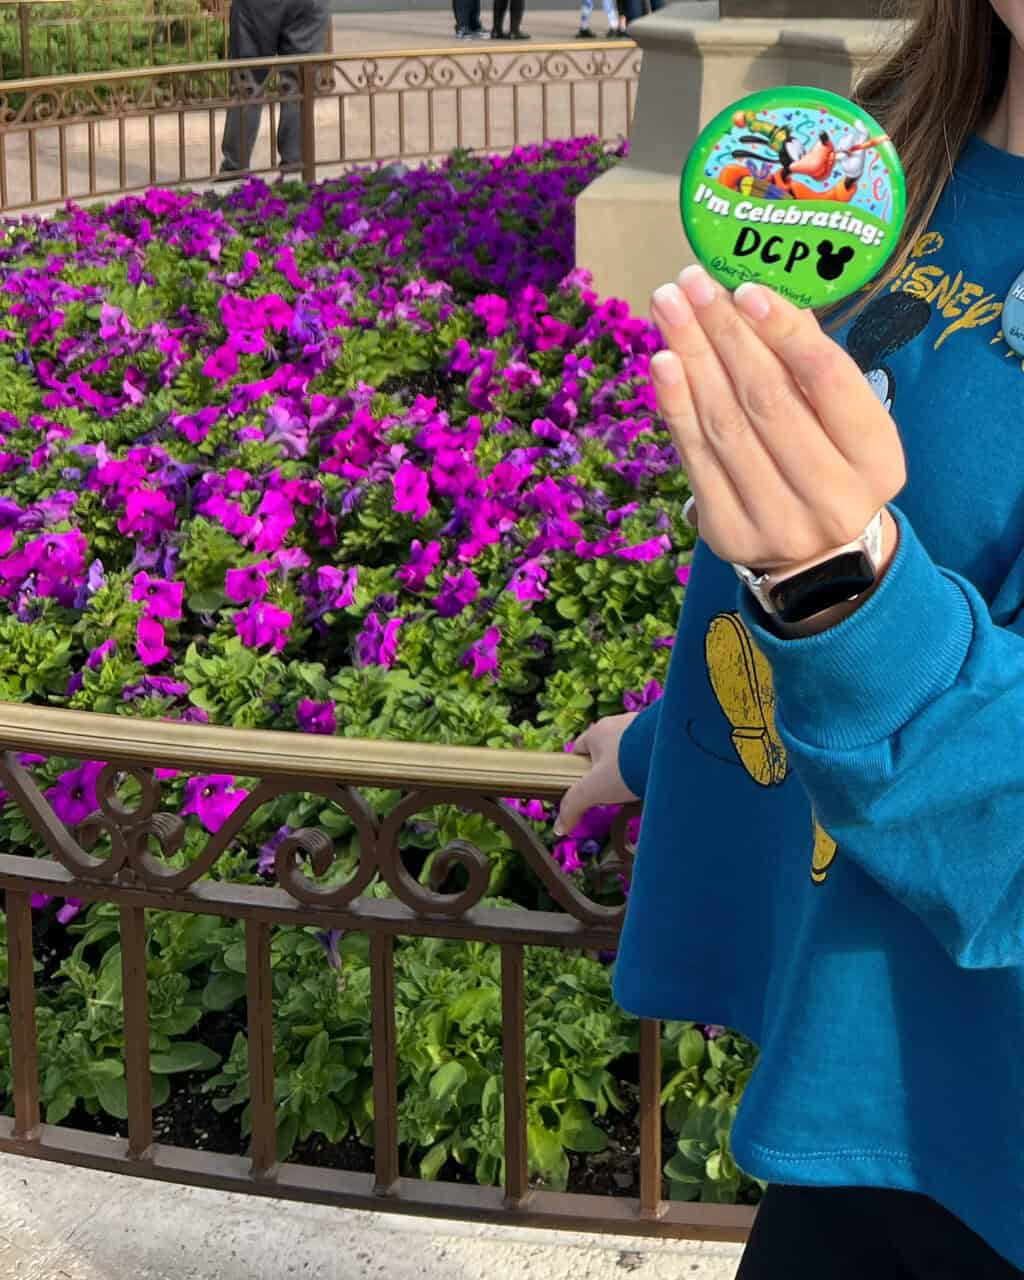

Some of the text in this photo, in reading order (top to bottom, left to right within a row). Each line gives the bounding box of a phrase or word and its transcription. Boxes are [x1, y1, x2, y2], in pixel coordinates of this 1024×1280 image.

[693, 184, 885, 246] I'm Celebrating:
[732, 226, 810, 273] DCP
